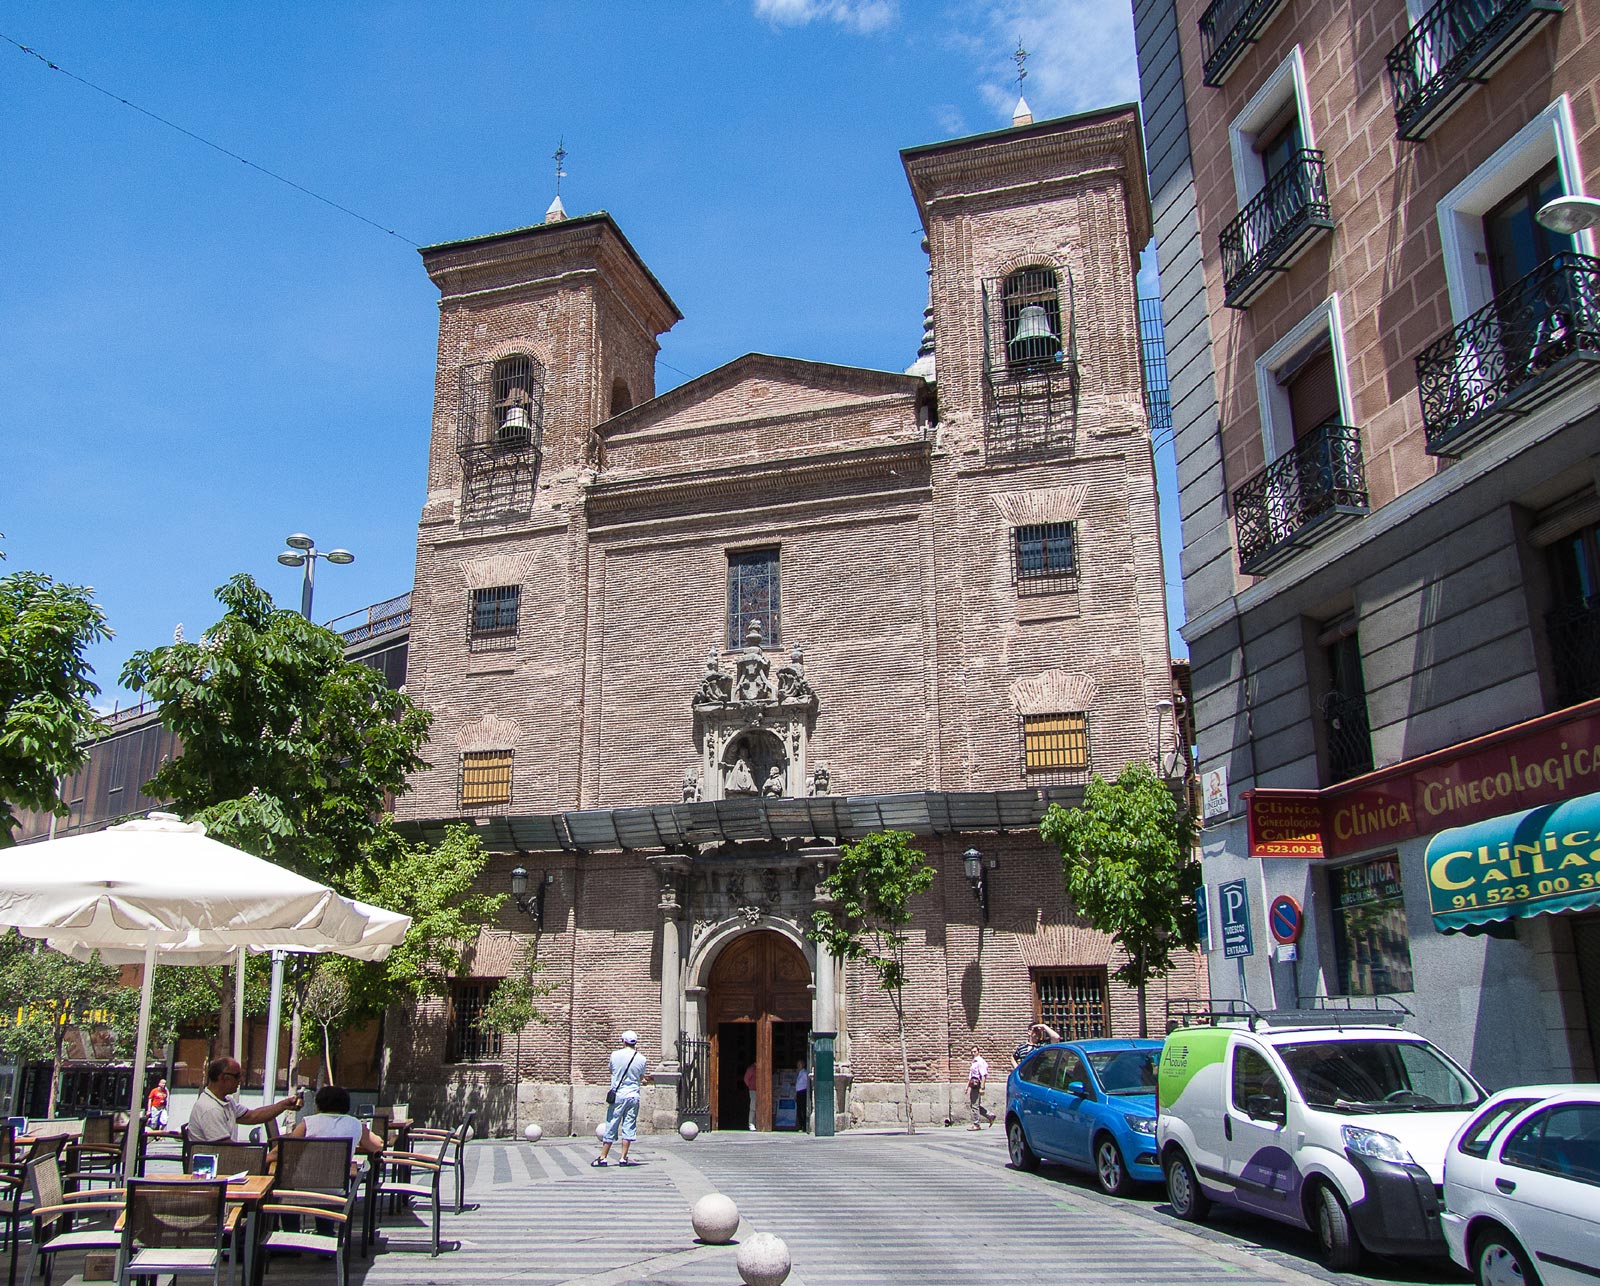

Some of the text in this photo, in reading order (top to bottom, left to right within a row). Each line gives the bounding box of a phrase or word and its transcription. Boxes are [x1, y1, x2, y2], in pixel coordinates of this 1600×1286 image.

[1224, 890, 1244, 925] P
[1452, 892, 1478, 908] 91
[1486, 884, 1531, 904] 523
[1538, 877, 1570, 895] 00
[1226, 944, 1249, 956] ENTRADA
